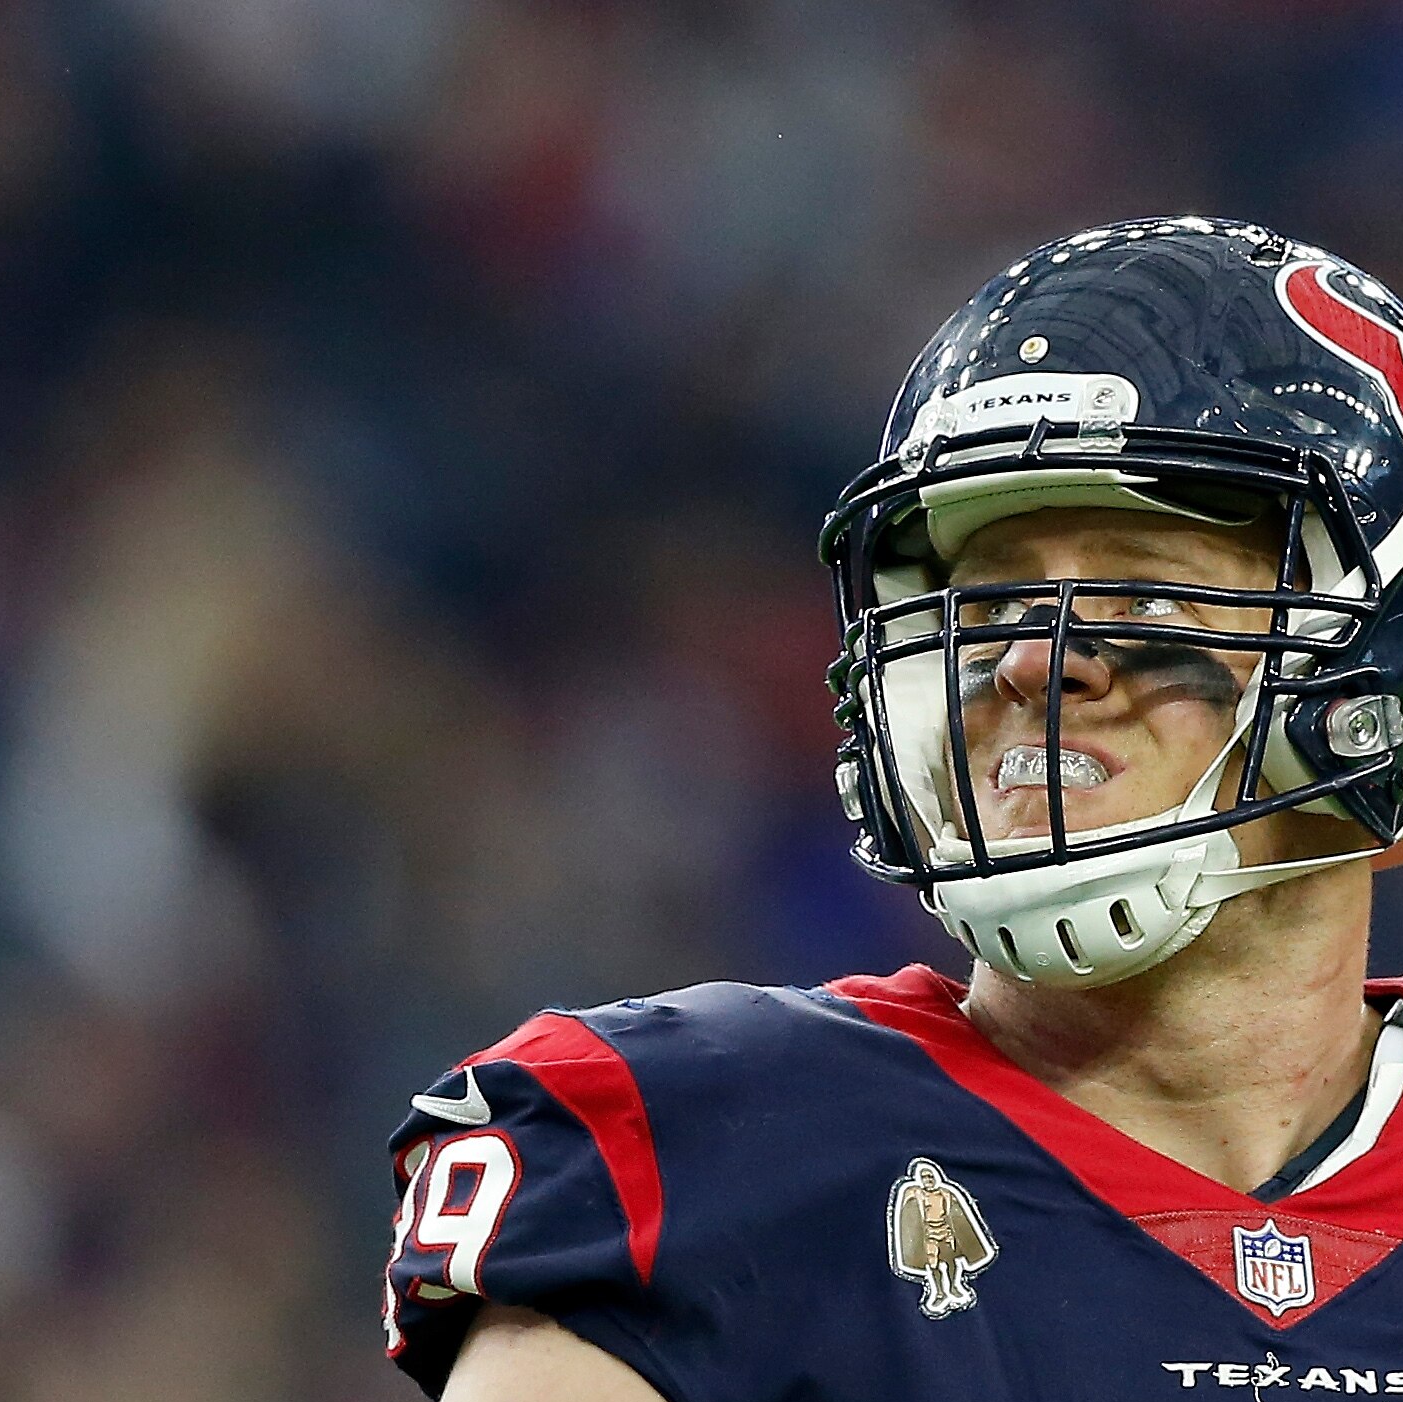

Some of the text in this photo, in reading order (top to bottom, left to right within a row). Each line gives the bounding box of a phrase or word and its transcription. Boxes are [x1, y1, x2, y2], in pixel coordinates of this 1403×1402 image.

[968, 392, 1072, 413] TEXANS
[382, 1128, 524, 1358] 9
[1250, 1260, 1302, 1297] NFL
